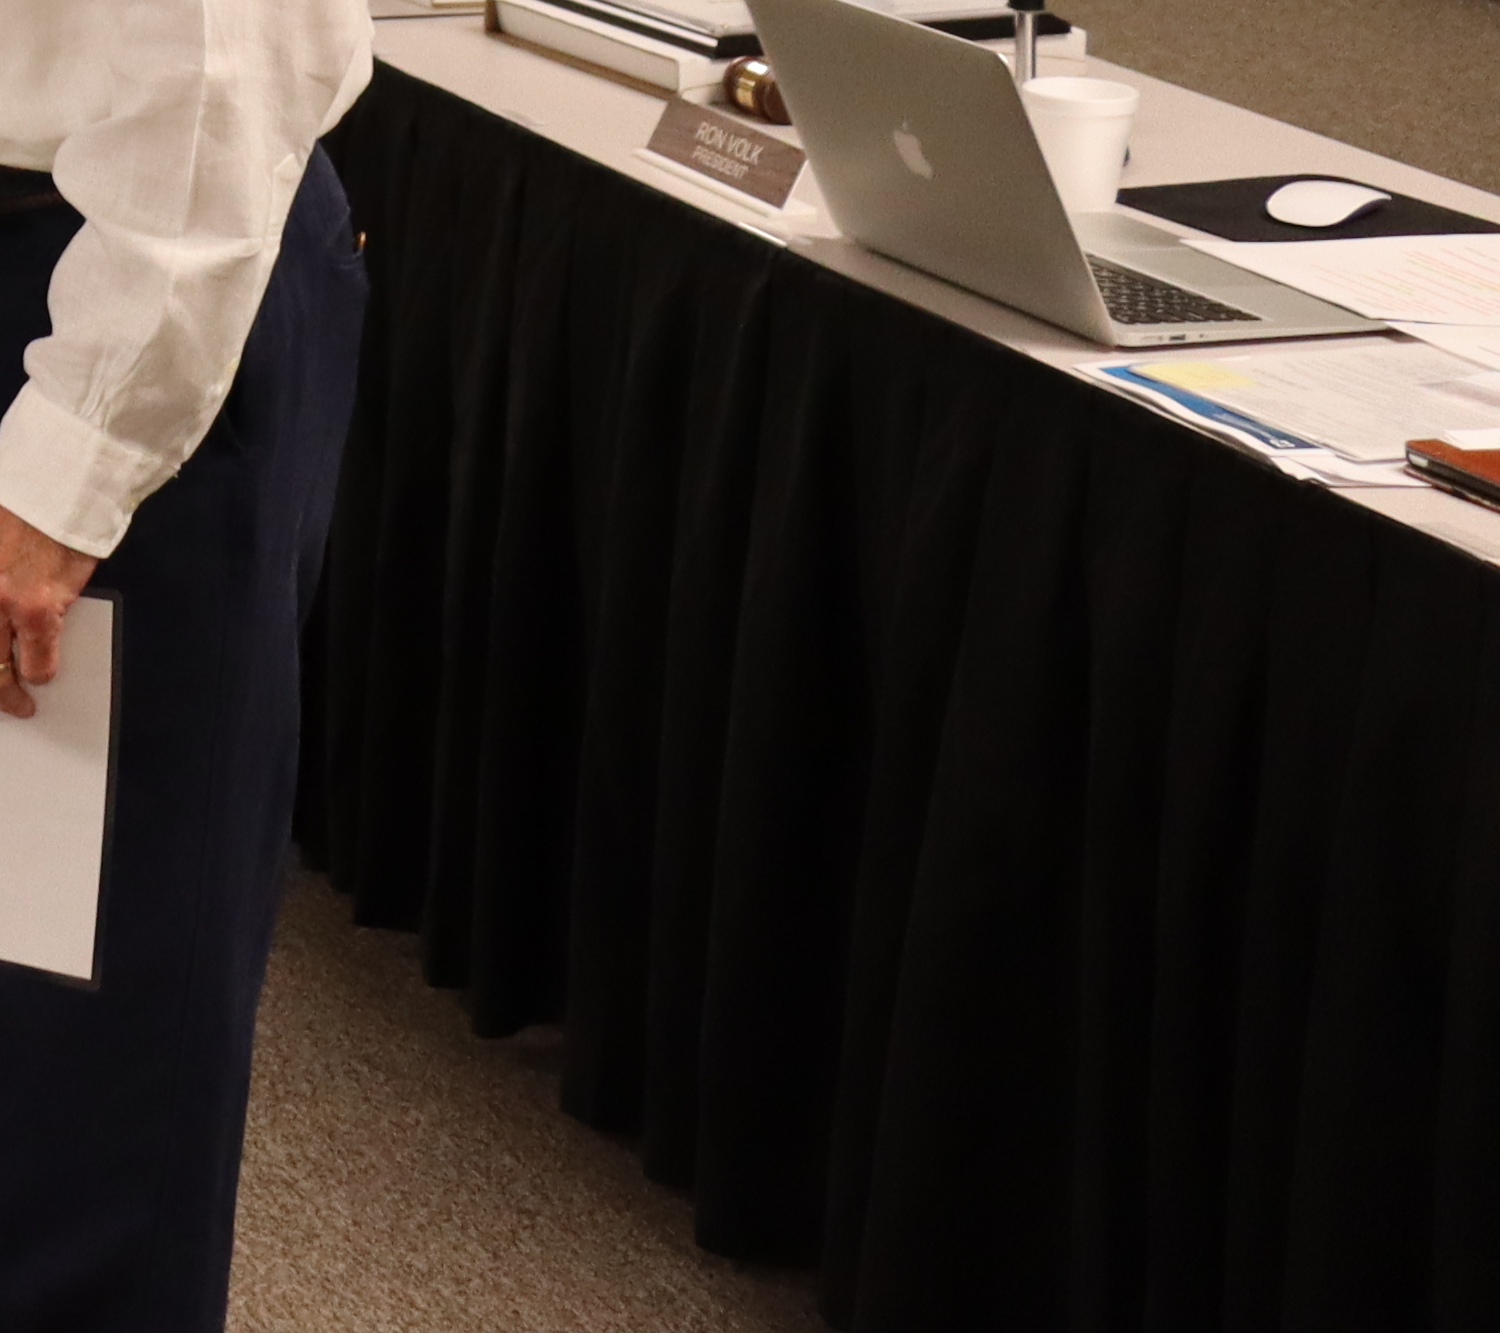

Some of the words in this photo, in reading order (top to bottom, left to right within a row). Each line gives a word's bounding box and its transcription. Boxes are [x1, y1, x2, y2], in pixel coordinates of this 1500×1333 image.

[692, 145, 749, 179] PRESIDENT
[695, 121, 728, 148] RON
[726, 132, 764, 165] VOLK
